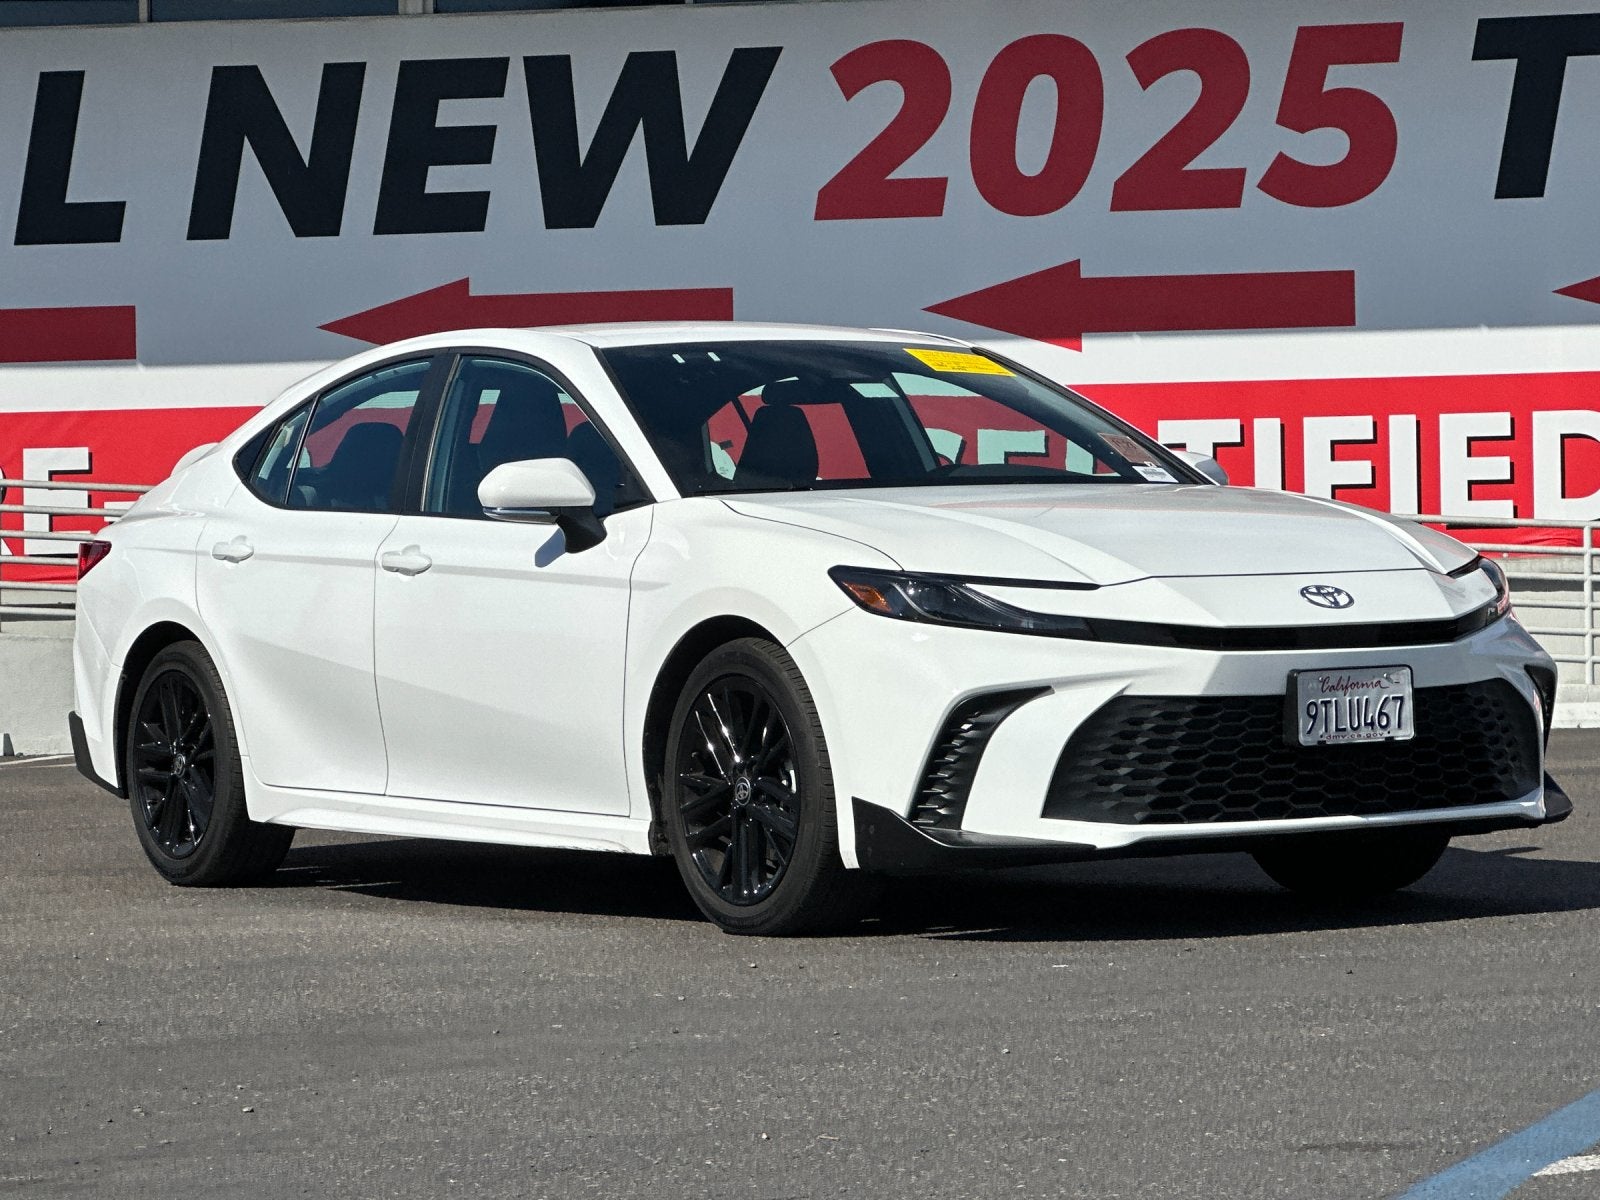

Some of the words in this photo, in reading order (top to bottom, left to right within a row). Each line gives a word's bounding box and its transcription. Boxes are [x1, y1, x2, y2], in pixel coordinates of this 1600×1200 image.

[187, 46, 783, 240] NEW
[814, 22, 1404, 219] 2025
[1321, 675, 1390, 697] California
[1306, 695, 1405, 735] 9TLU467
[1325, 732, 1385, 741] dmv.ca.gov
